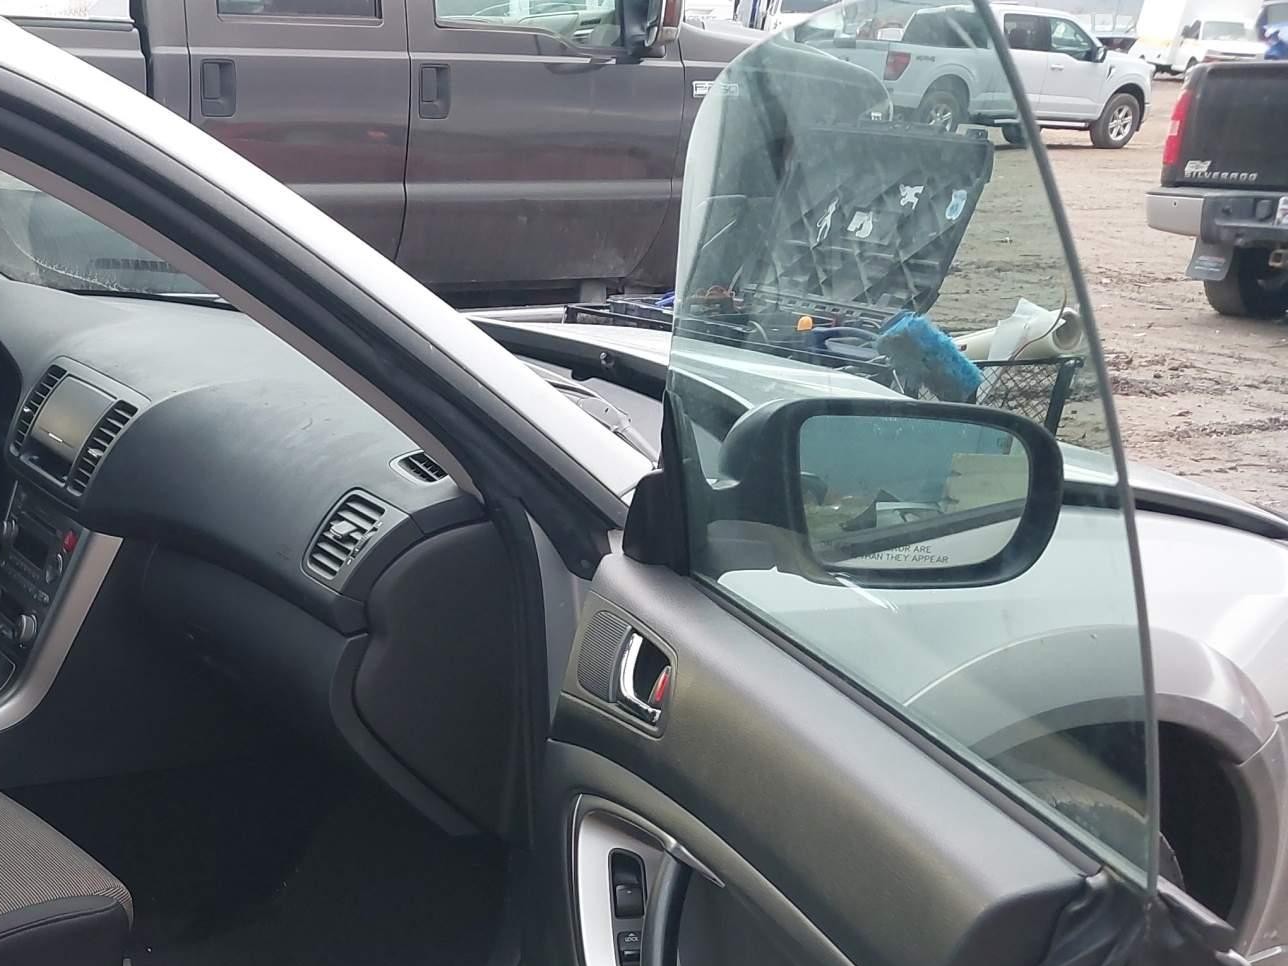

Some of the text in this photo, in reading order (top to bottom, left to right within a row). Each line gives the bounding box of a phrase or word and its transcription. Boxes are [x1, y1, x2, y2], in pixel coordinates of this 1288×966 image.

[913, 545, 932, 553] ARE
[886, 554, 908, 562] THEY
[912, 554, 949, 563] APPEAR
